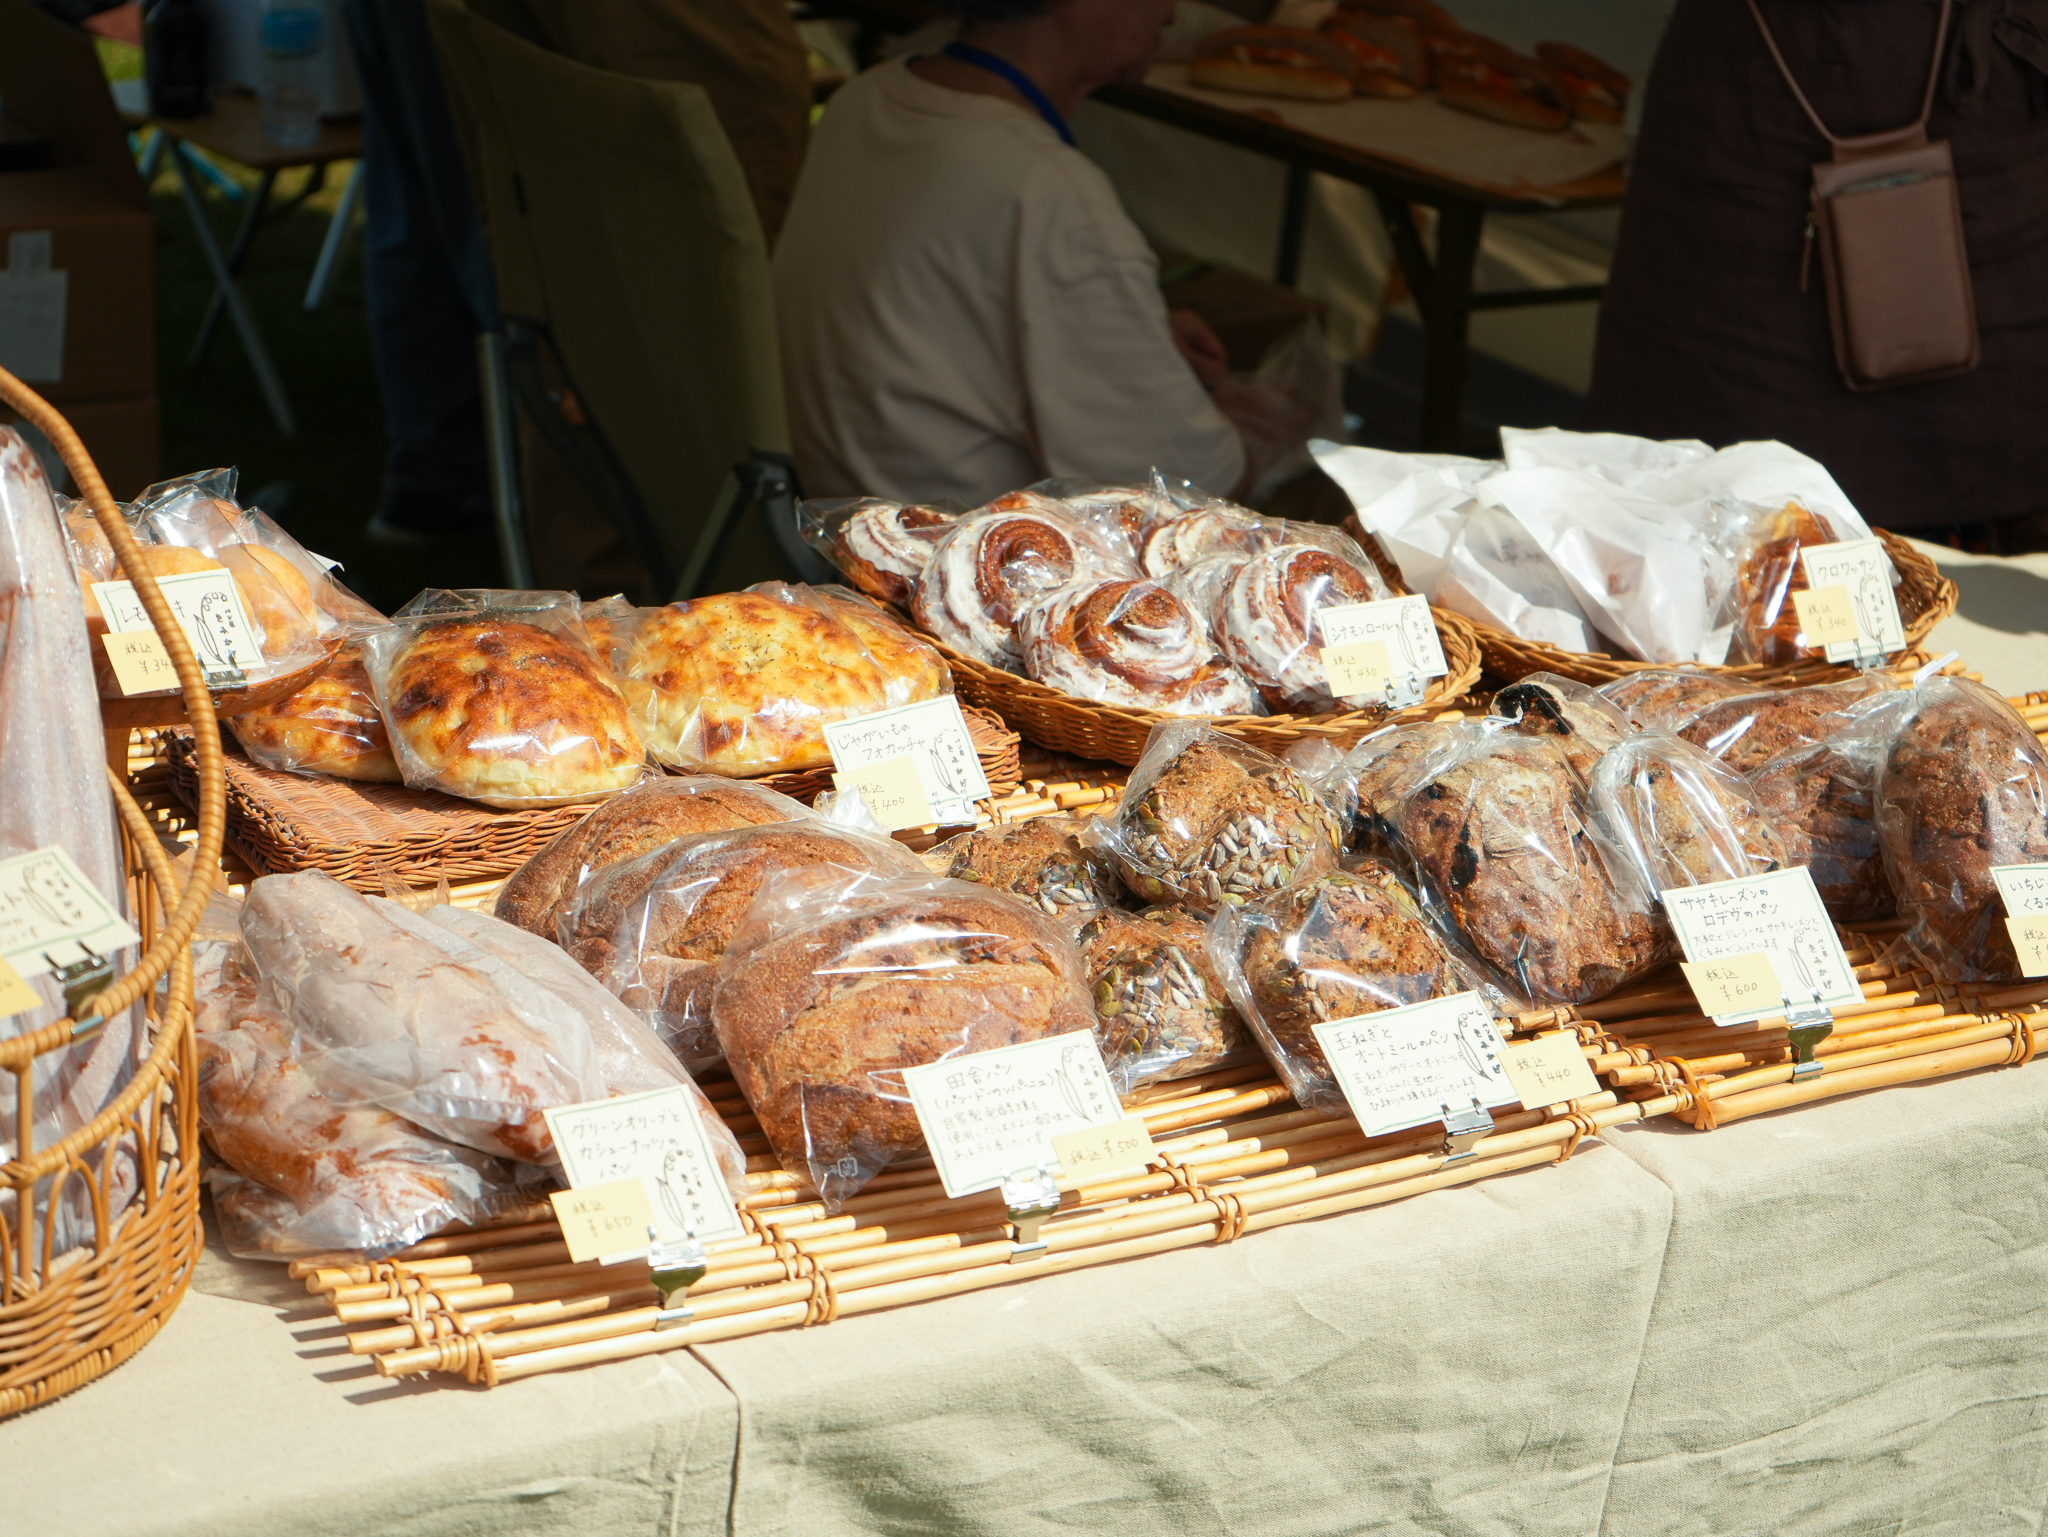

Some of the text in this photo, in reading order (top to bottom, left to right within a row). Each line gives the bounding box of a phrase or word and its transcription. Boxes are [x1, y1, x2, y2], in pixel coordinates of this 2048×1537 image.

[1819, 558, 1877, 582] クロワッサン
[1330, 622, 1395, 642] シナモンロール
[1815, 616, 1847, 634] ¥340
[125, 641, 153, 656] 税込
[1333, 655, 1356, 666] 税込
[1343, 668, 1377, 685] ¥430
[838, 722, 911, 751] じゃがいもの
[862, 737, 926, 761] フォカッチャ
[856, 782, 885, 794] 税込
[869, 796, 906, 816] ¥400
[2010, 876, 2048, 892] いちじ
[1679, 887, 1769, 911] サヤキレーズンの
[1703, 903, 1779, 928] ロデヴのパン
[2023, 928, 2047, 941] 税込
[1698, 937, 1780, 959] くるみが入っています
[1705, 967, 1740, 982] 税込
[1808, 943, 1833, 990] きみかげ
[1719, 982, 1758, 1002] ¥600
[1333, 1024, 1393, 1051] 玉ねぎと
[1354, 1029, 1449, 1064] オートミールのパン
[1516, 1056, 1546, 1072] 税込
[945, 1063, 1012, 1090] 田舎パン
[1533, 1068, 1571, 1089] ¥440
[572, 1108, 682, 1139] グリーンオリーブと
[580, 1137, 679, 1160] カシューナッツの
[1070, 1138, 1139, 1166] 税込 ¥500
[598, 1163, 632, 1179] パン
[573, 1199, 607, 1215] 税込
[585, 1216, 633, 1238] ¥650
